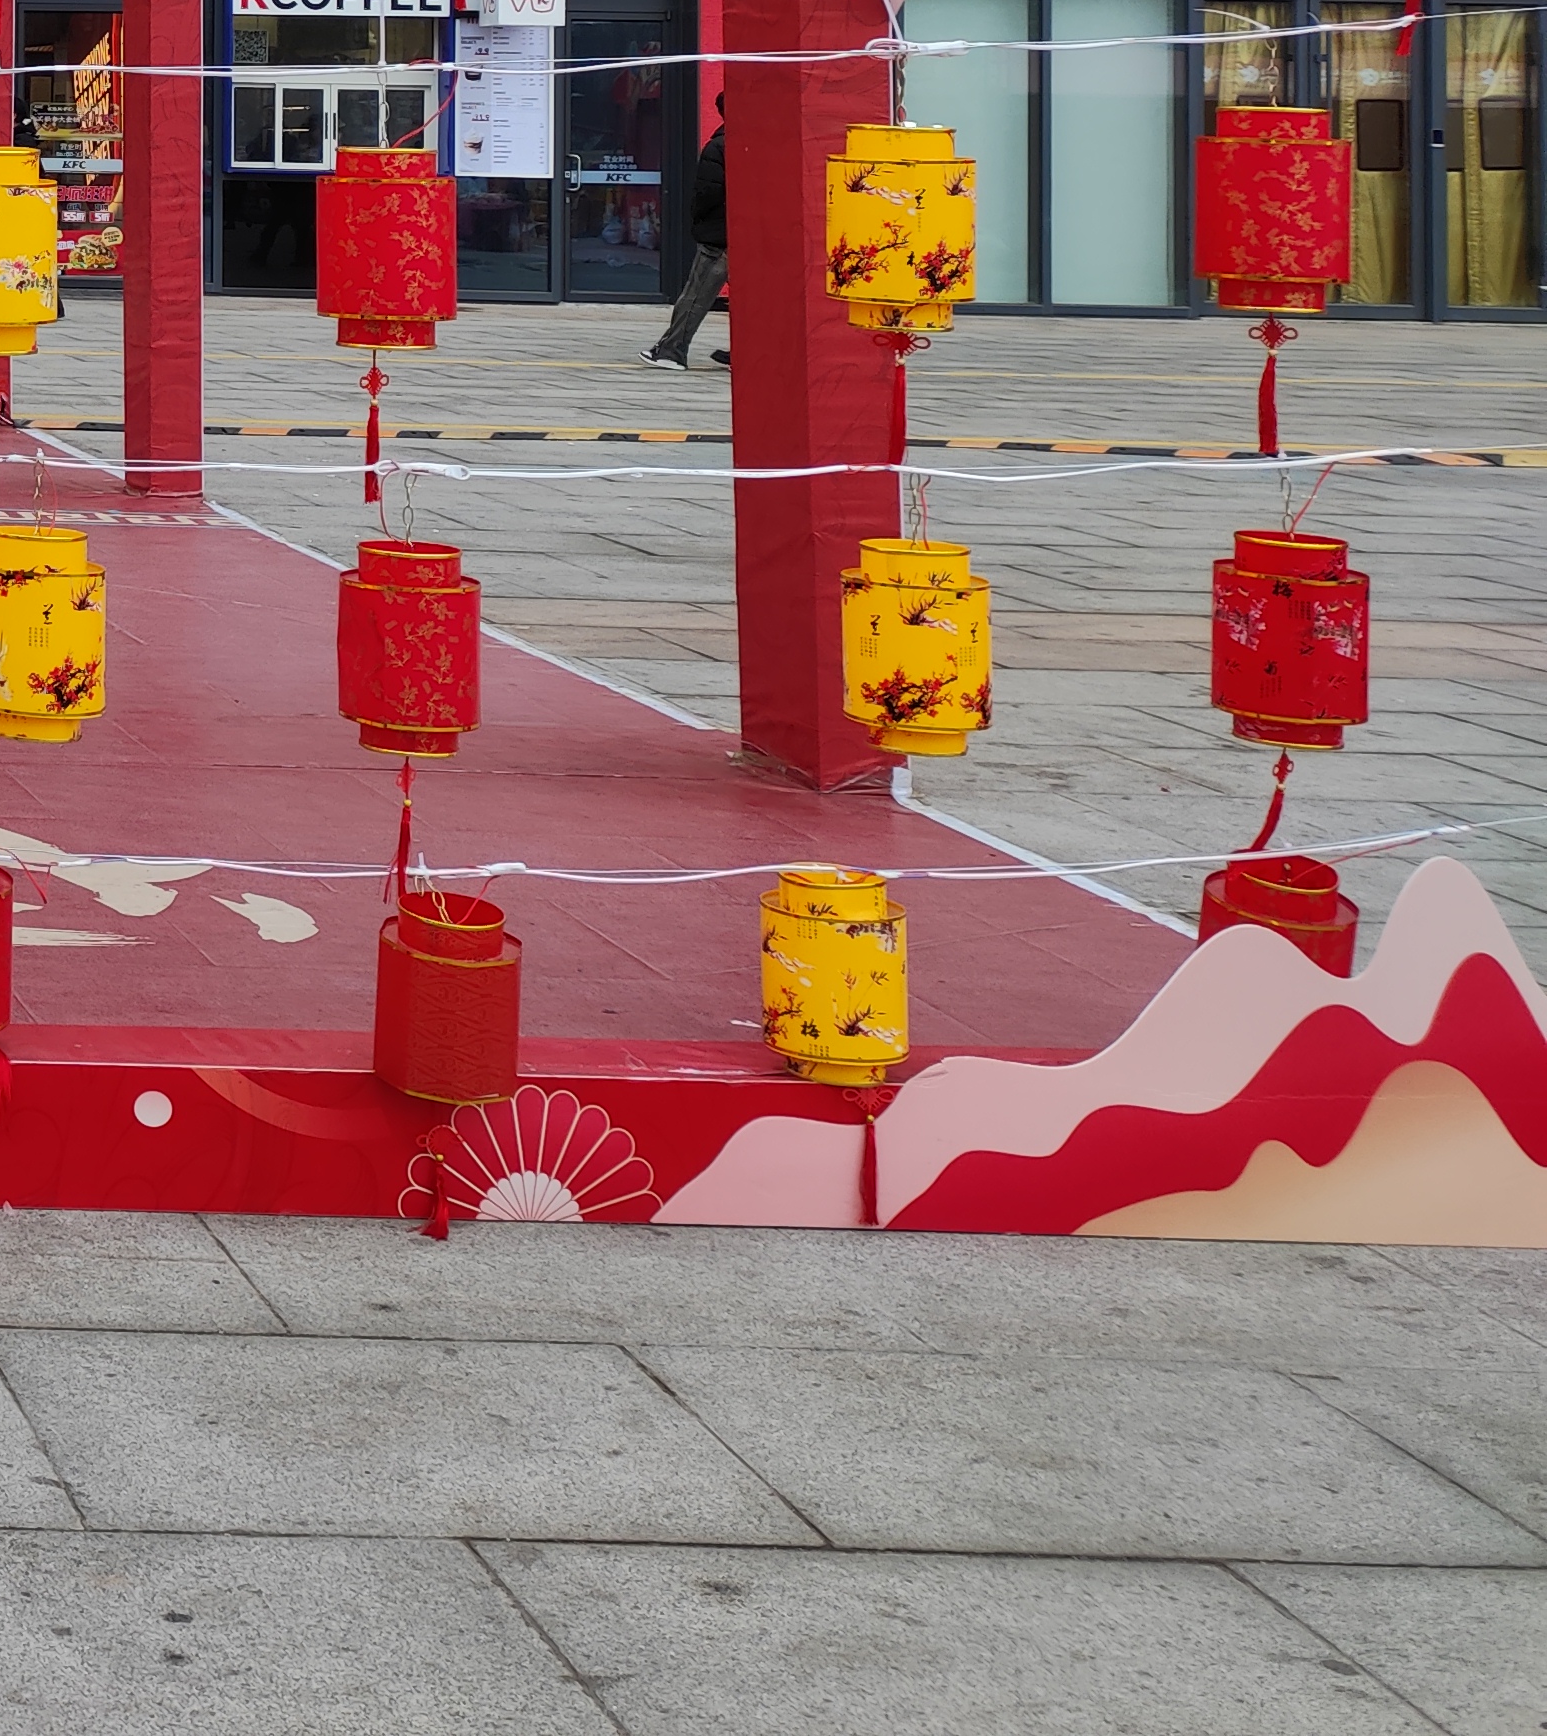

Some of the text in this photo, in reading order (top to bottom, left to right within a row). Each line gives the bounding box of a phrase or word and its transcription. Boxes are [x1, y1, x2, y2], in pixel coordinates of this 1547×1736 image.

[62, 160, 87, 169] KFC
[605, 173, 632, 182] KFC
[1272, 579, 1294, 599] 梅
[800, 1018, 820, 1039] 梅
